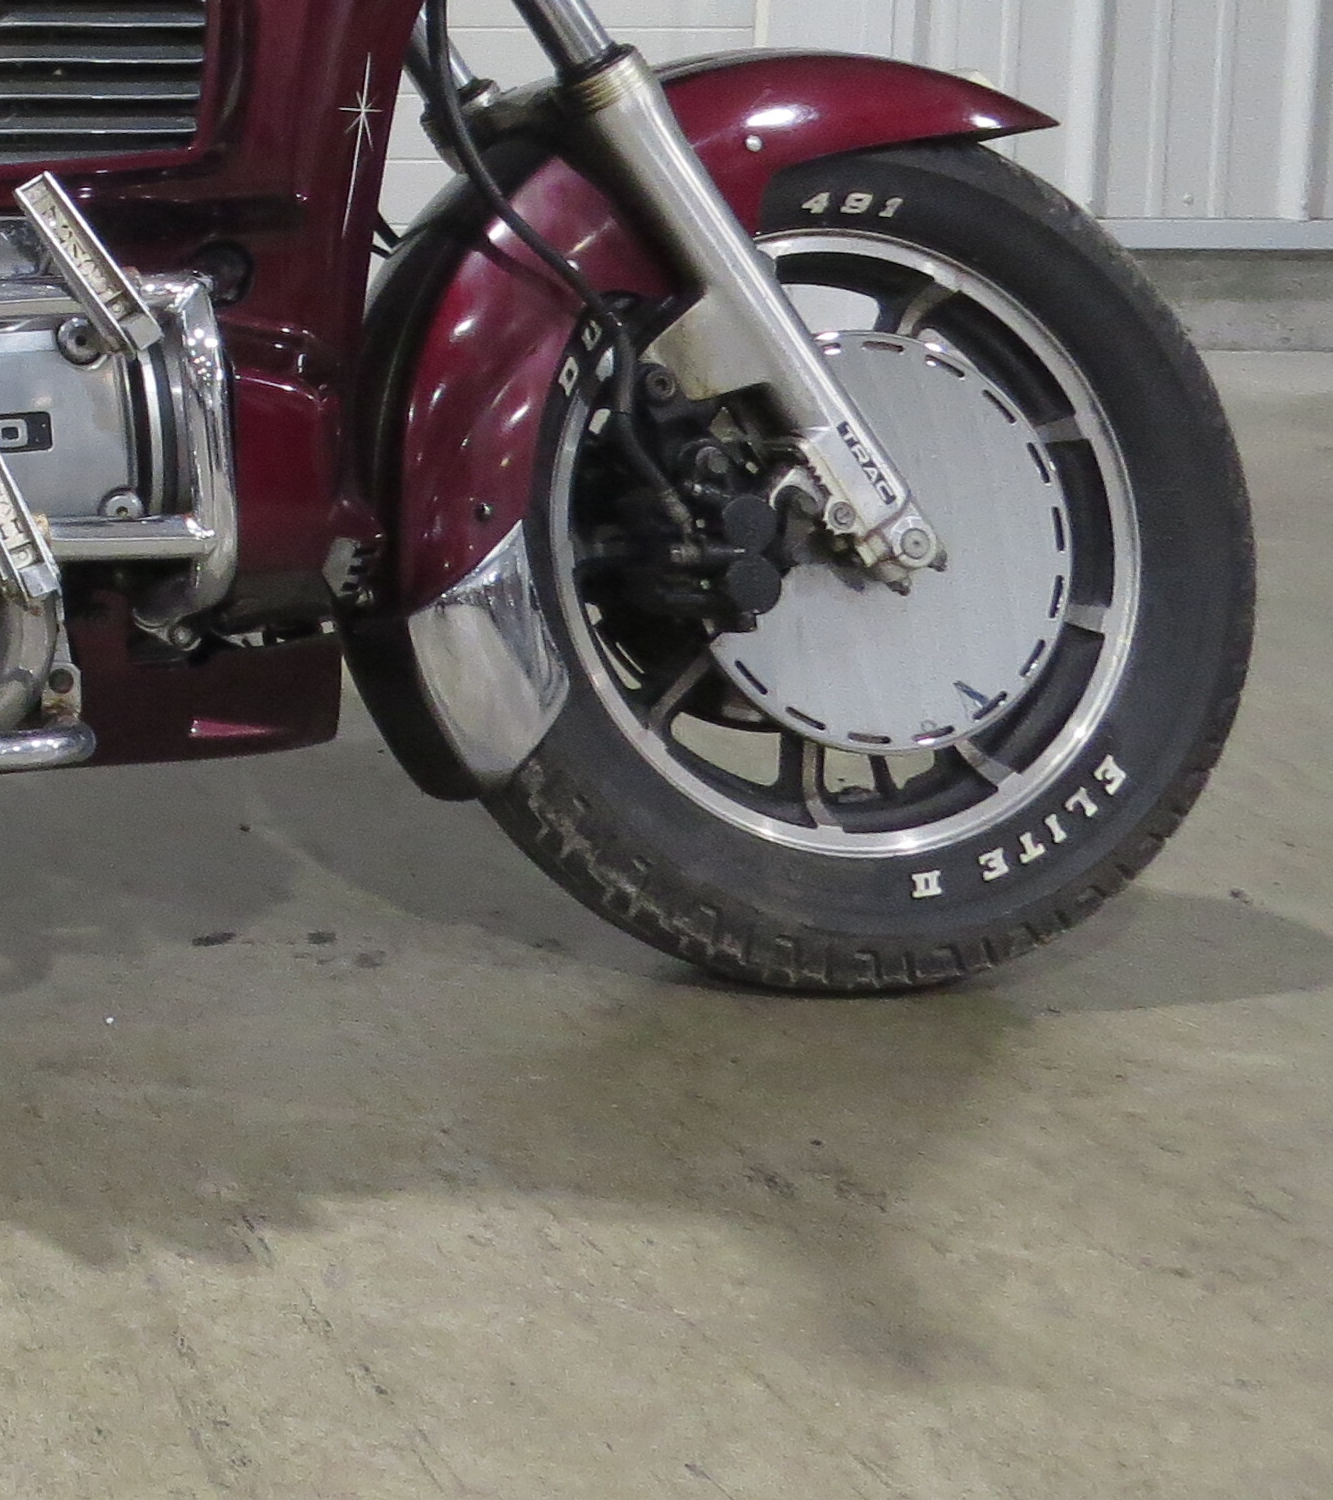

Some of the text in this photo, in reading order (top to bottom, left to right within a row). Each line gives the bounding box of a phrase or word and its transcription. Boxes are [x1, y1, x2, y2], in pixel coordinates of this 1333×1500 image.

[800, 191, 904, 218] 491
[837, 422, 898, 505] TRAC
[911, 753, 1127, 899] ELITE II
